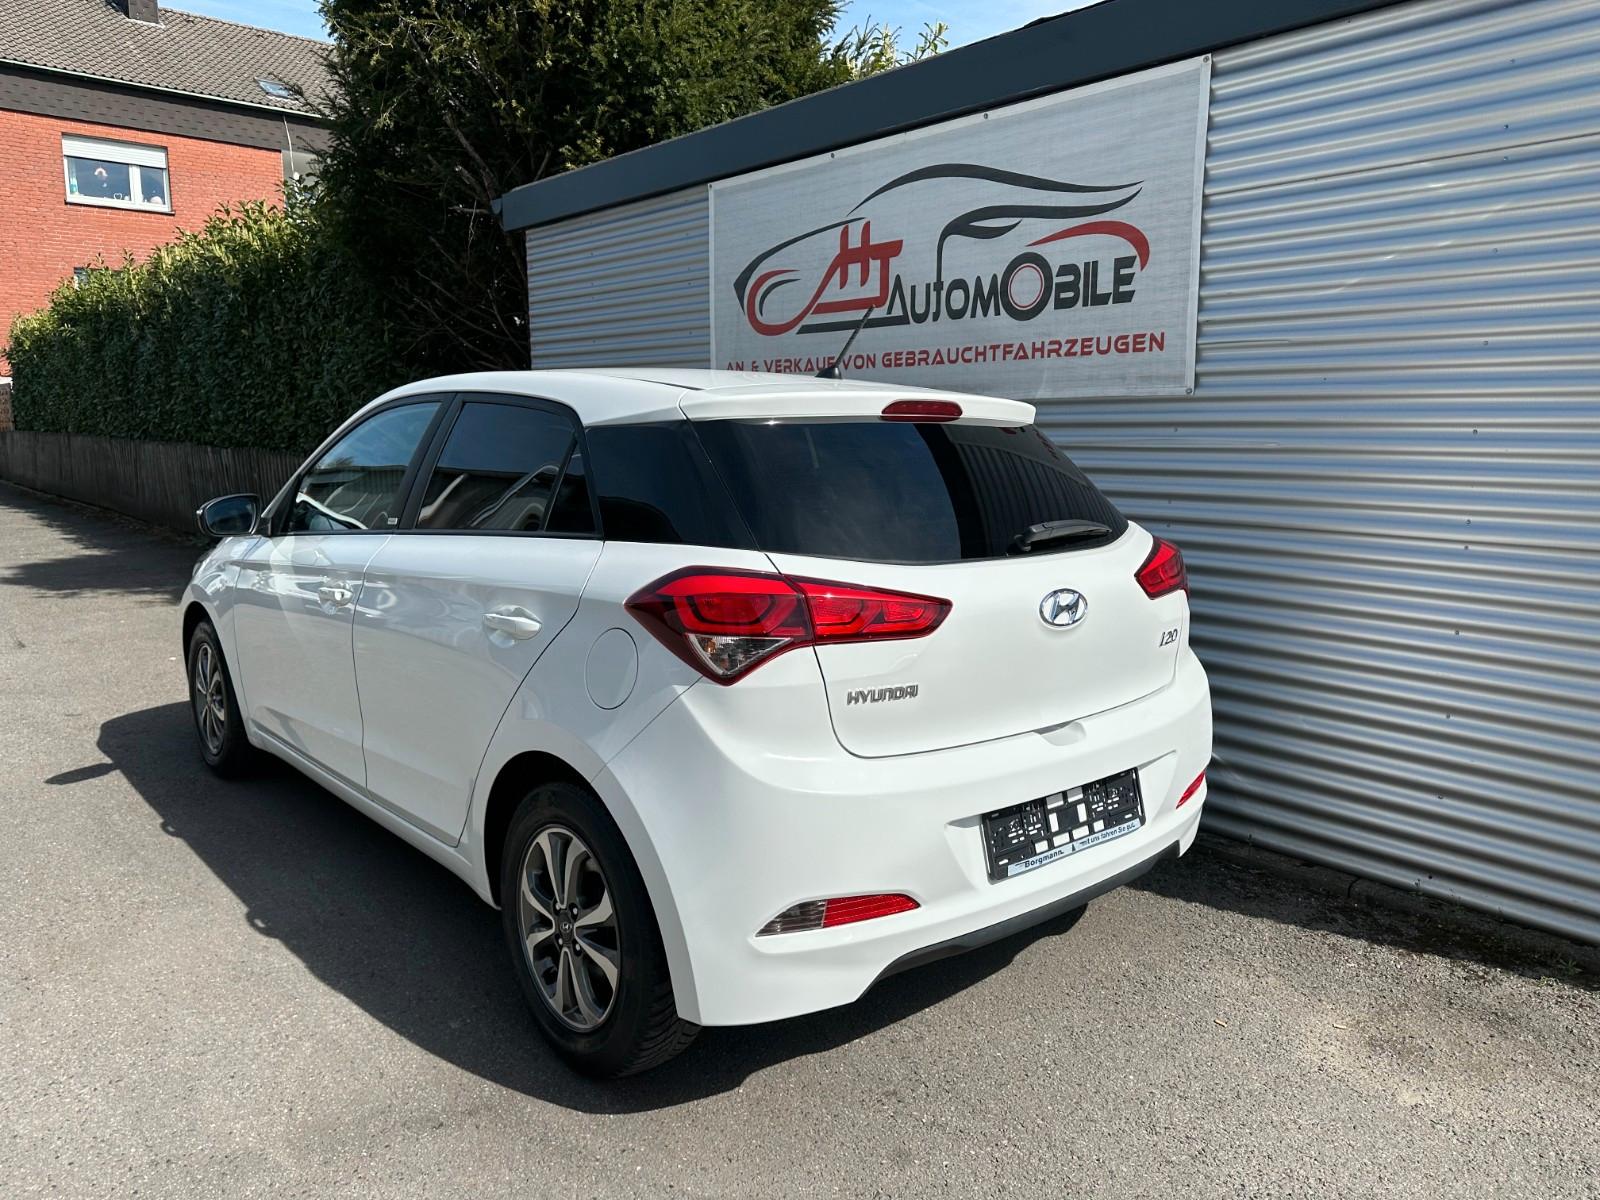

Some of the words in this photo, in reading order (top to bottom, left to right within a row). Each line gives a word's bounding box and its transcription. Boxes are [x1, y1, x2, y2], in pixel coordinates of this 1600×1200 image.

[727, 361, 744, 371] AN
[751, 360, 759, 371] &
[842, 353, 877, 370] VON
[881, 332, 1165, 368] GEBRAUCHTFAHRZEUGEN
[846, 684, 918, 706] HYUNDAI
